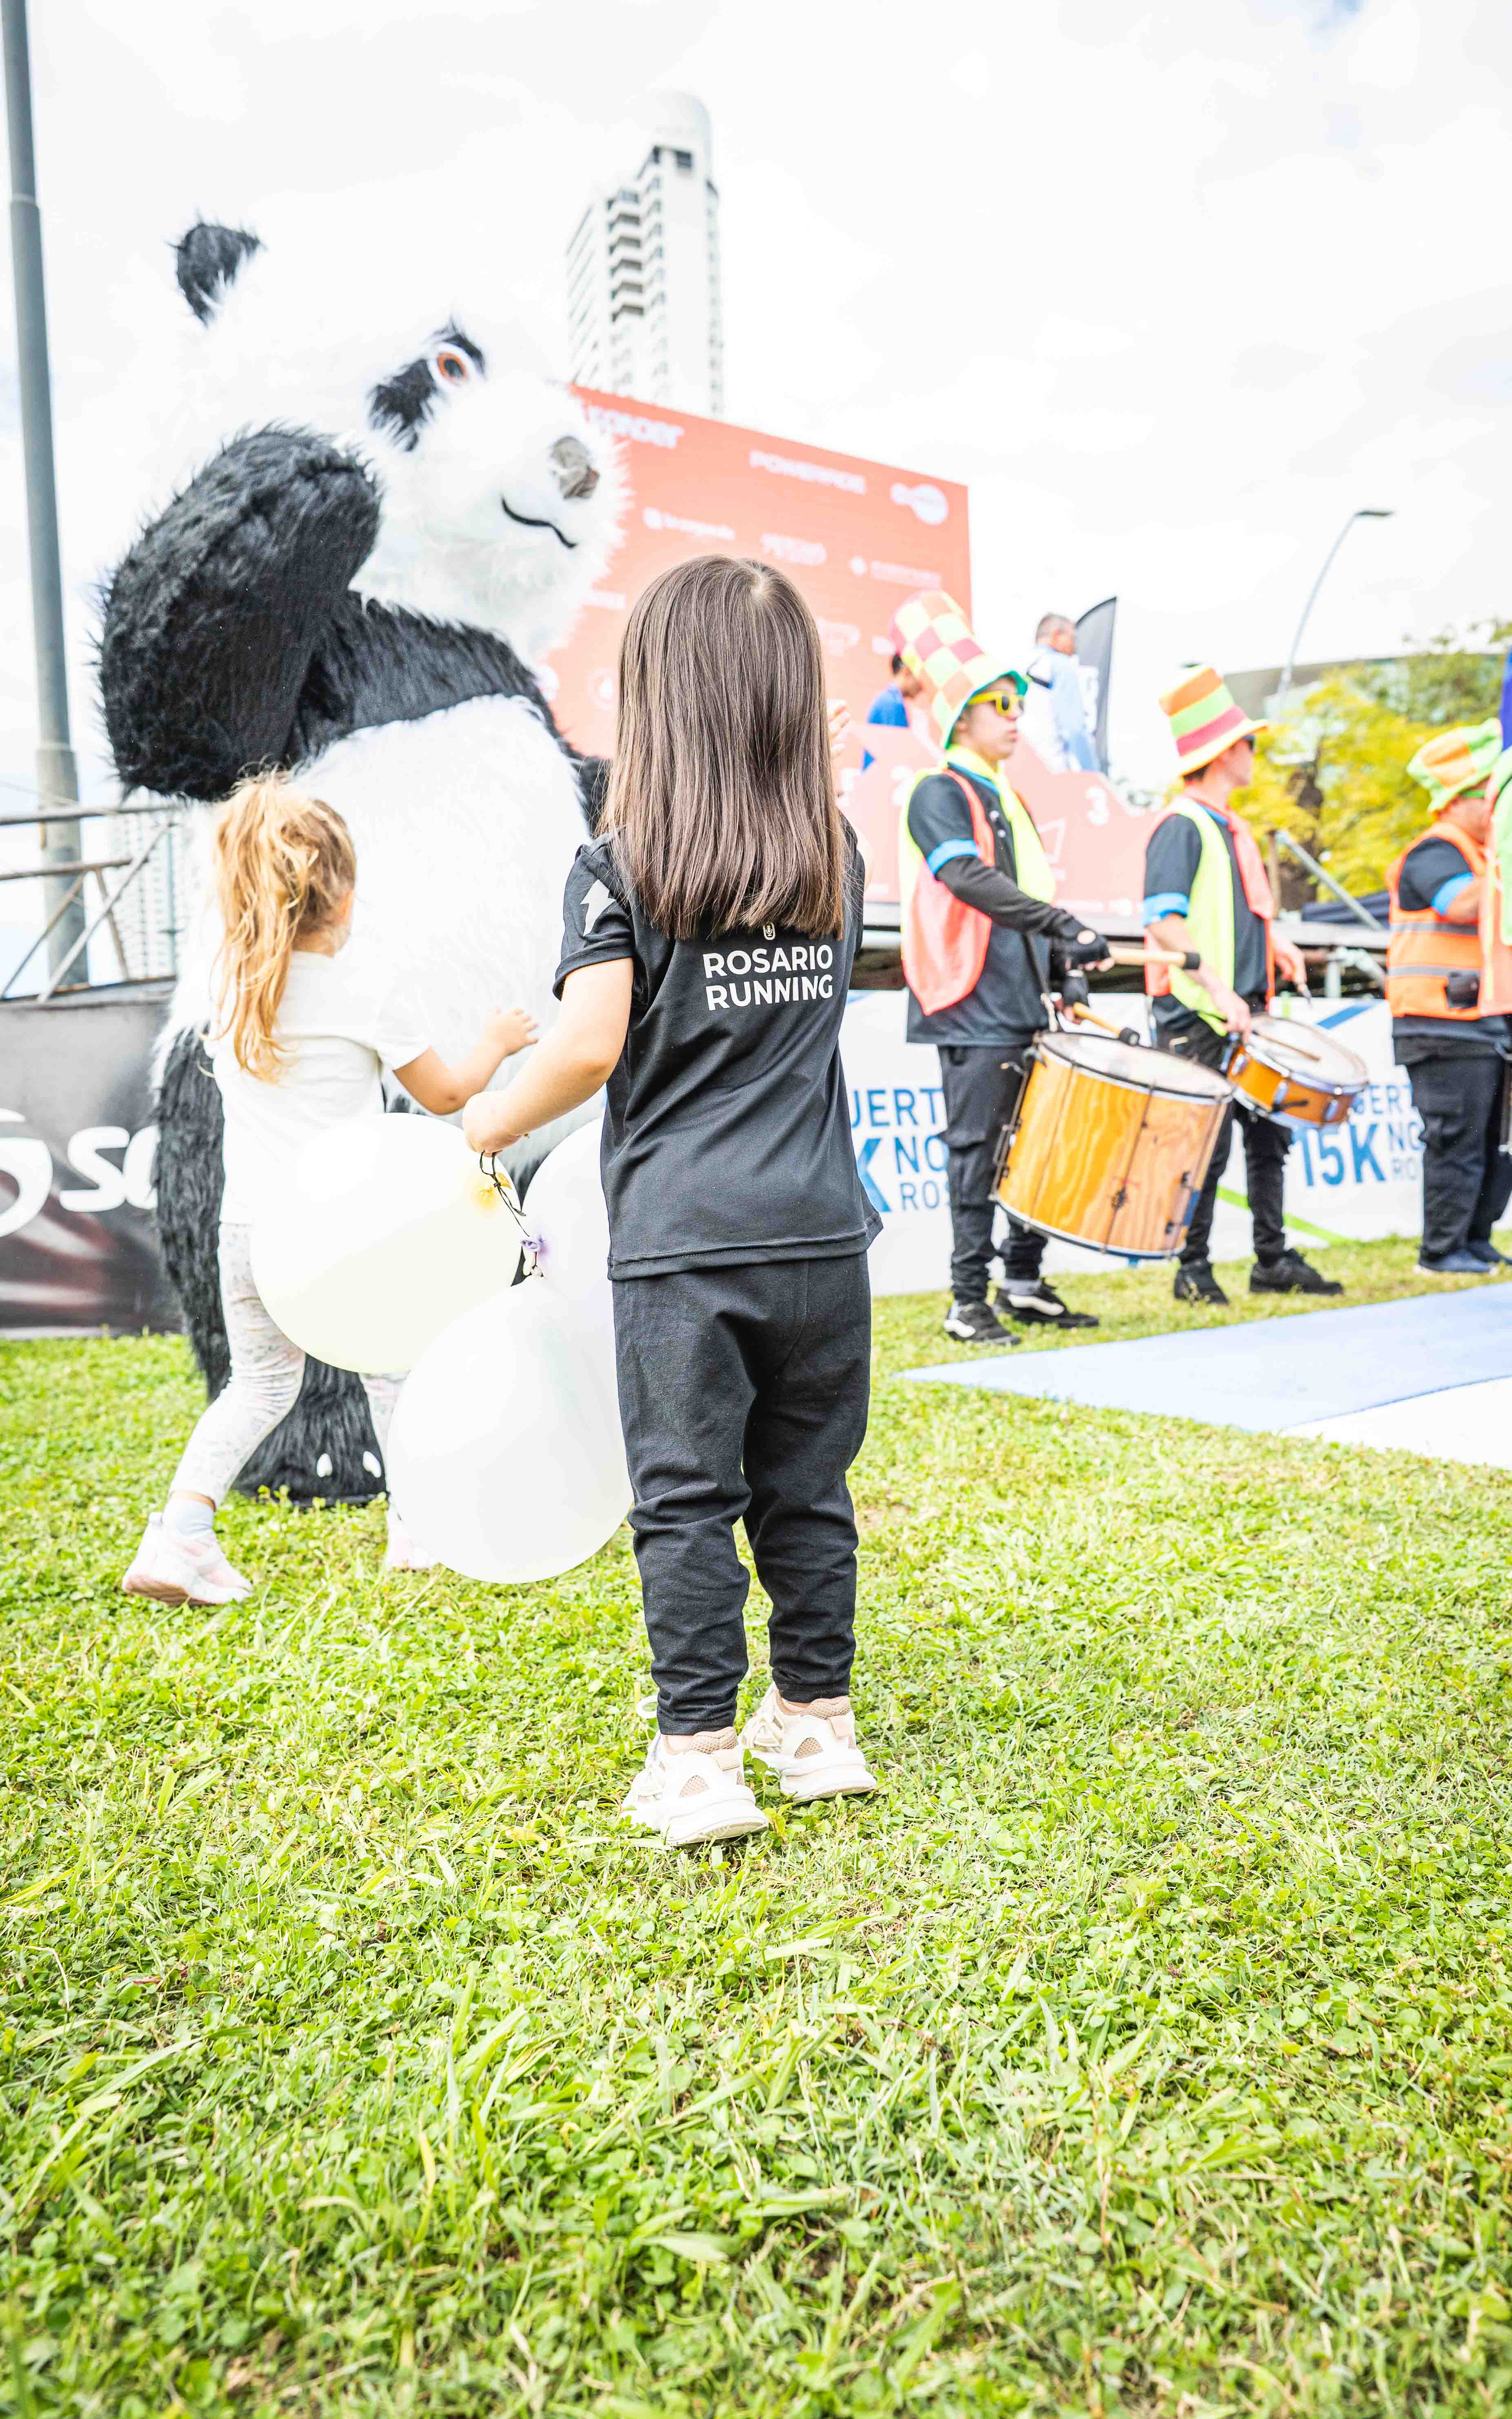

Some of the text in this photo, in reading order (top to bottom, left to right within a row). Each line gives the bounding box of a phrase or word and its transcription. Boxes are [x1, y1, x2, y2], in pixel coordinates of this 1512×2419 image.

[1085, 786, 1108, 826] 3
[702, 944, 833, 979] ROSARIO
[706, 974, 833, 1011] RUNNING
[1291, 1123, 1386, 1187] 15K
[900, 1180, 950, 1211] RO
